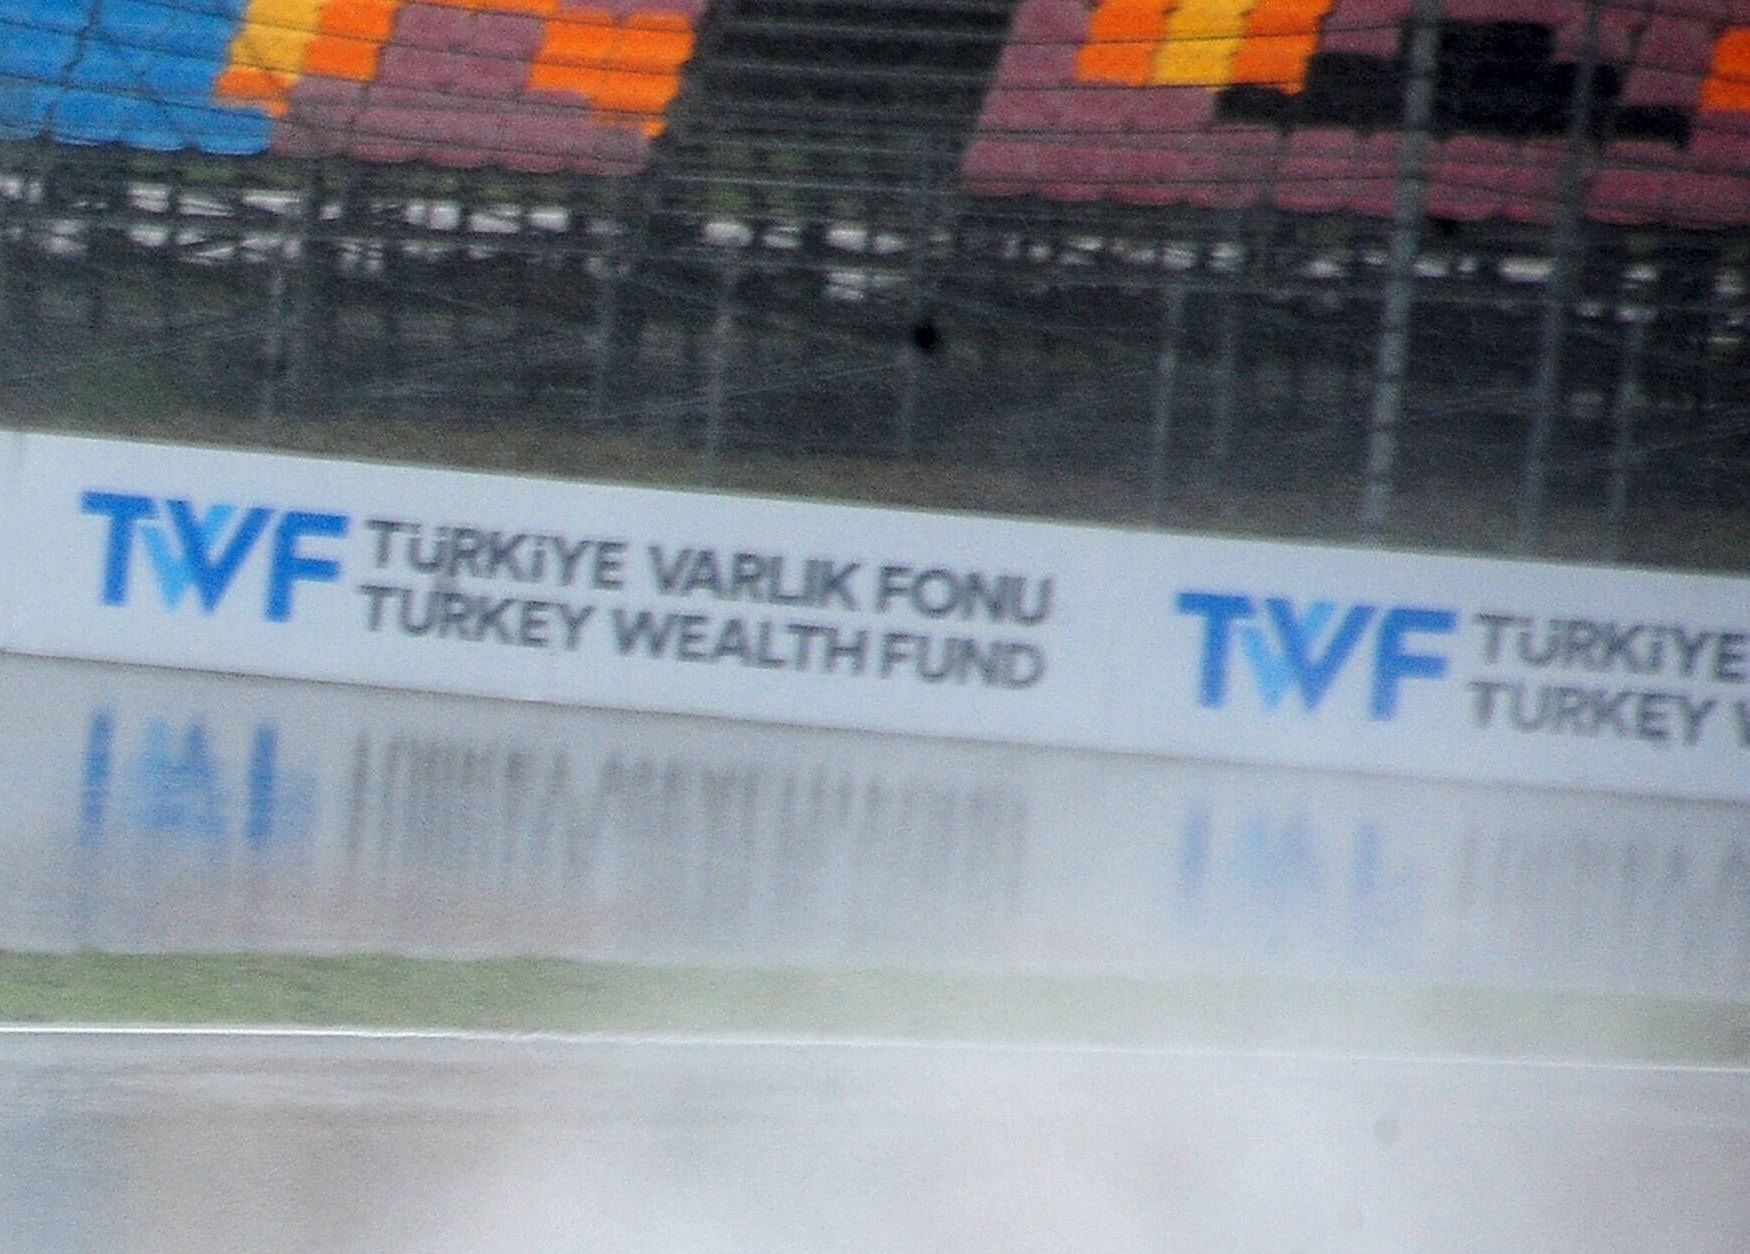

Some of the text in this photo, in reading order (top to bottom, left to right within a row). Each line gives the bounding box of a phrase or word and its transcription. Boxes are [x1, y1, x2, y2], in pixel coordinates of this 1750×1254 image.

[648, 545, 861, 612] VARLIK
[876, 563, 1053, 628] FONU
[358, 584, 1045, 690] TURKEY WEALTH FUND
[1468, 680, 1719, 746] TURKEY
